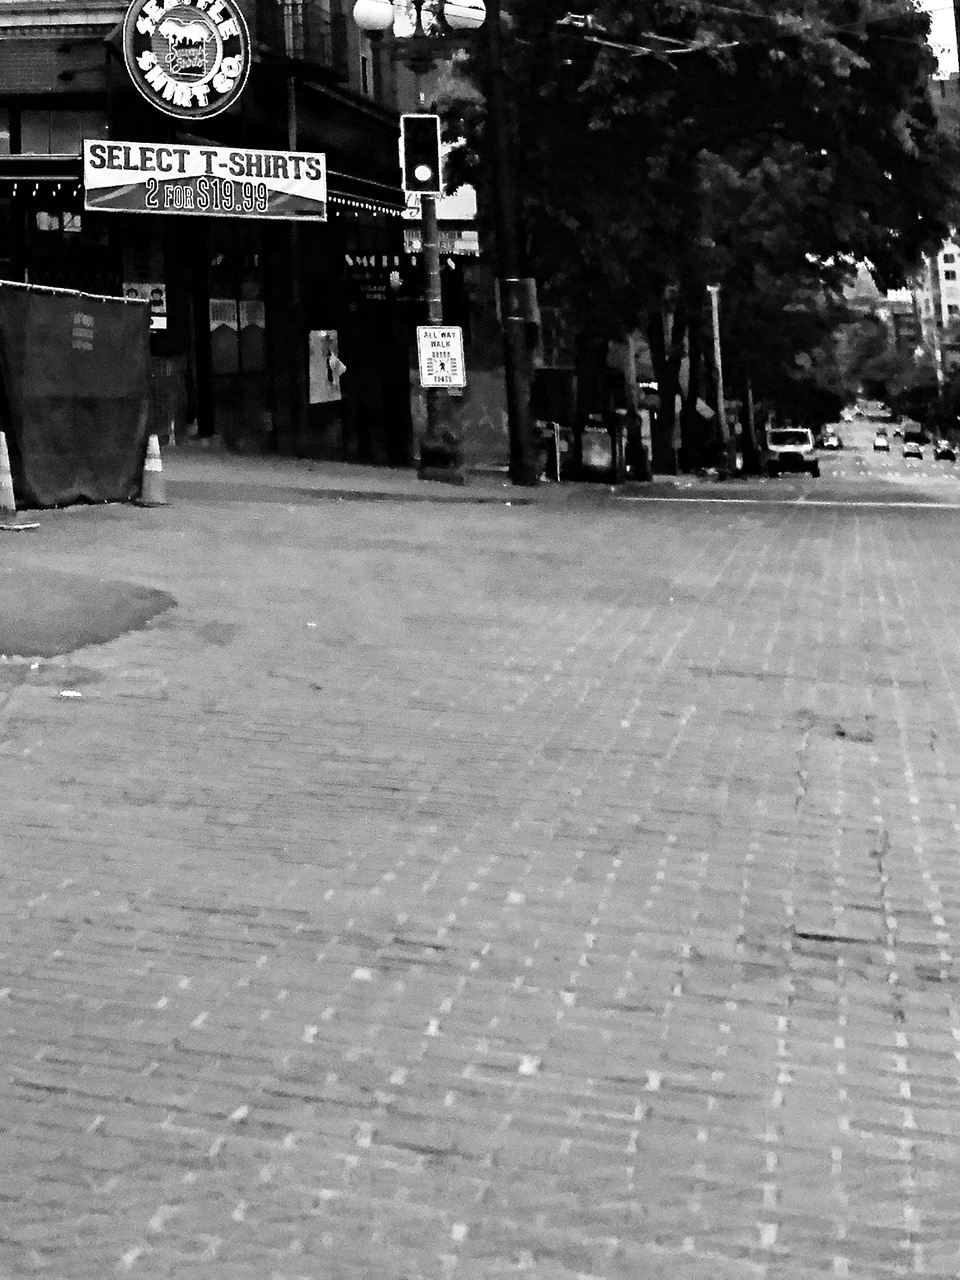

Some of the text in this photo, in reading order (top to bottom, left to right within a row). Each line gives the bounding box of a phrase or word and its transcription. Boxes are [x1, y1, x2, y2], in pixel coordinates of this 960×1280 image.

[136, 50, 211, 107] SHIRT
[90, 144, 322, 180] SELECT T-SHIRTS
[145, 177, 269, 213] 2 FOR $19.99
[430, 340, 451, 348] WALK
